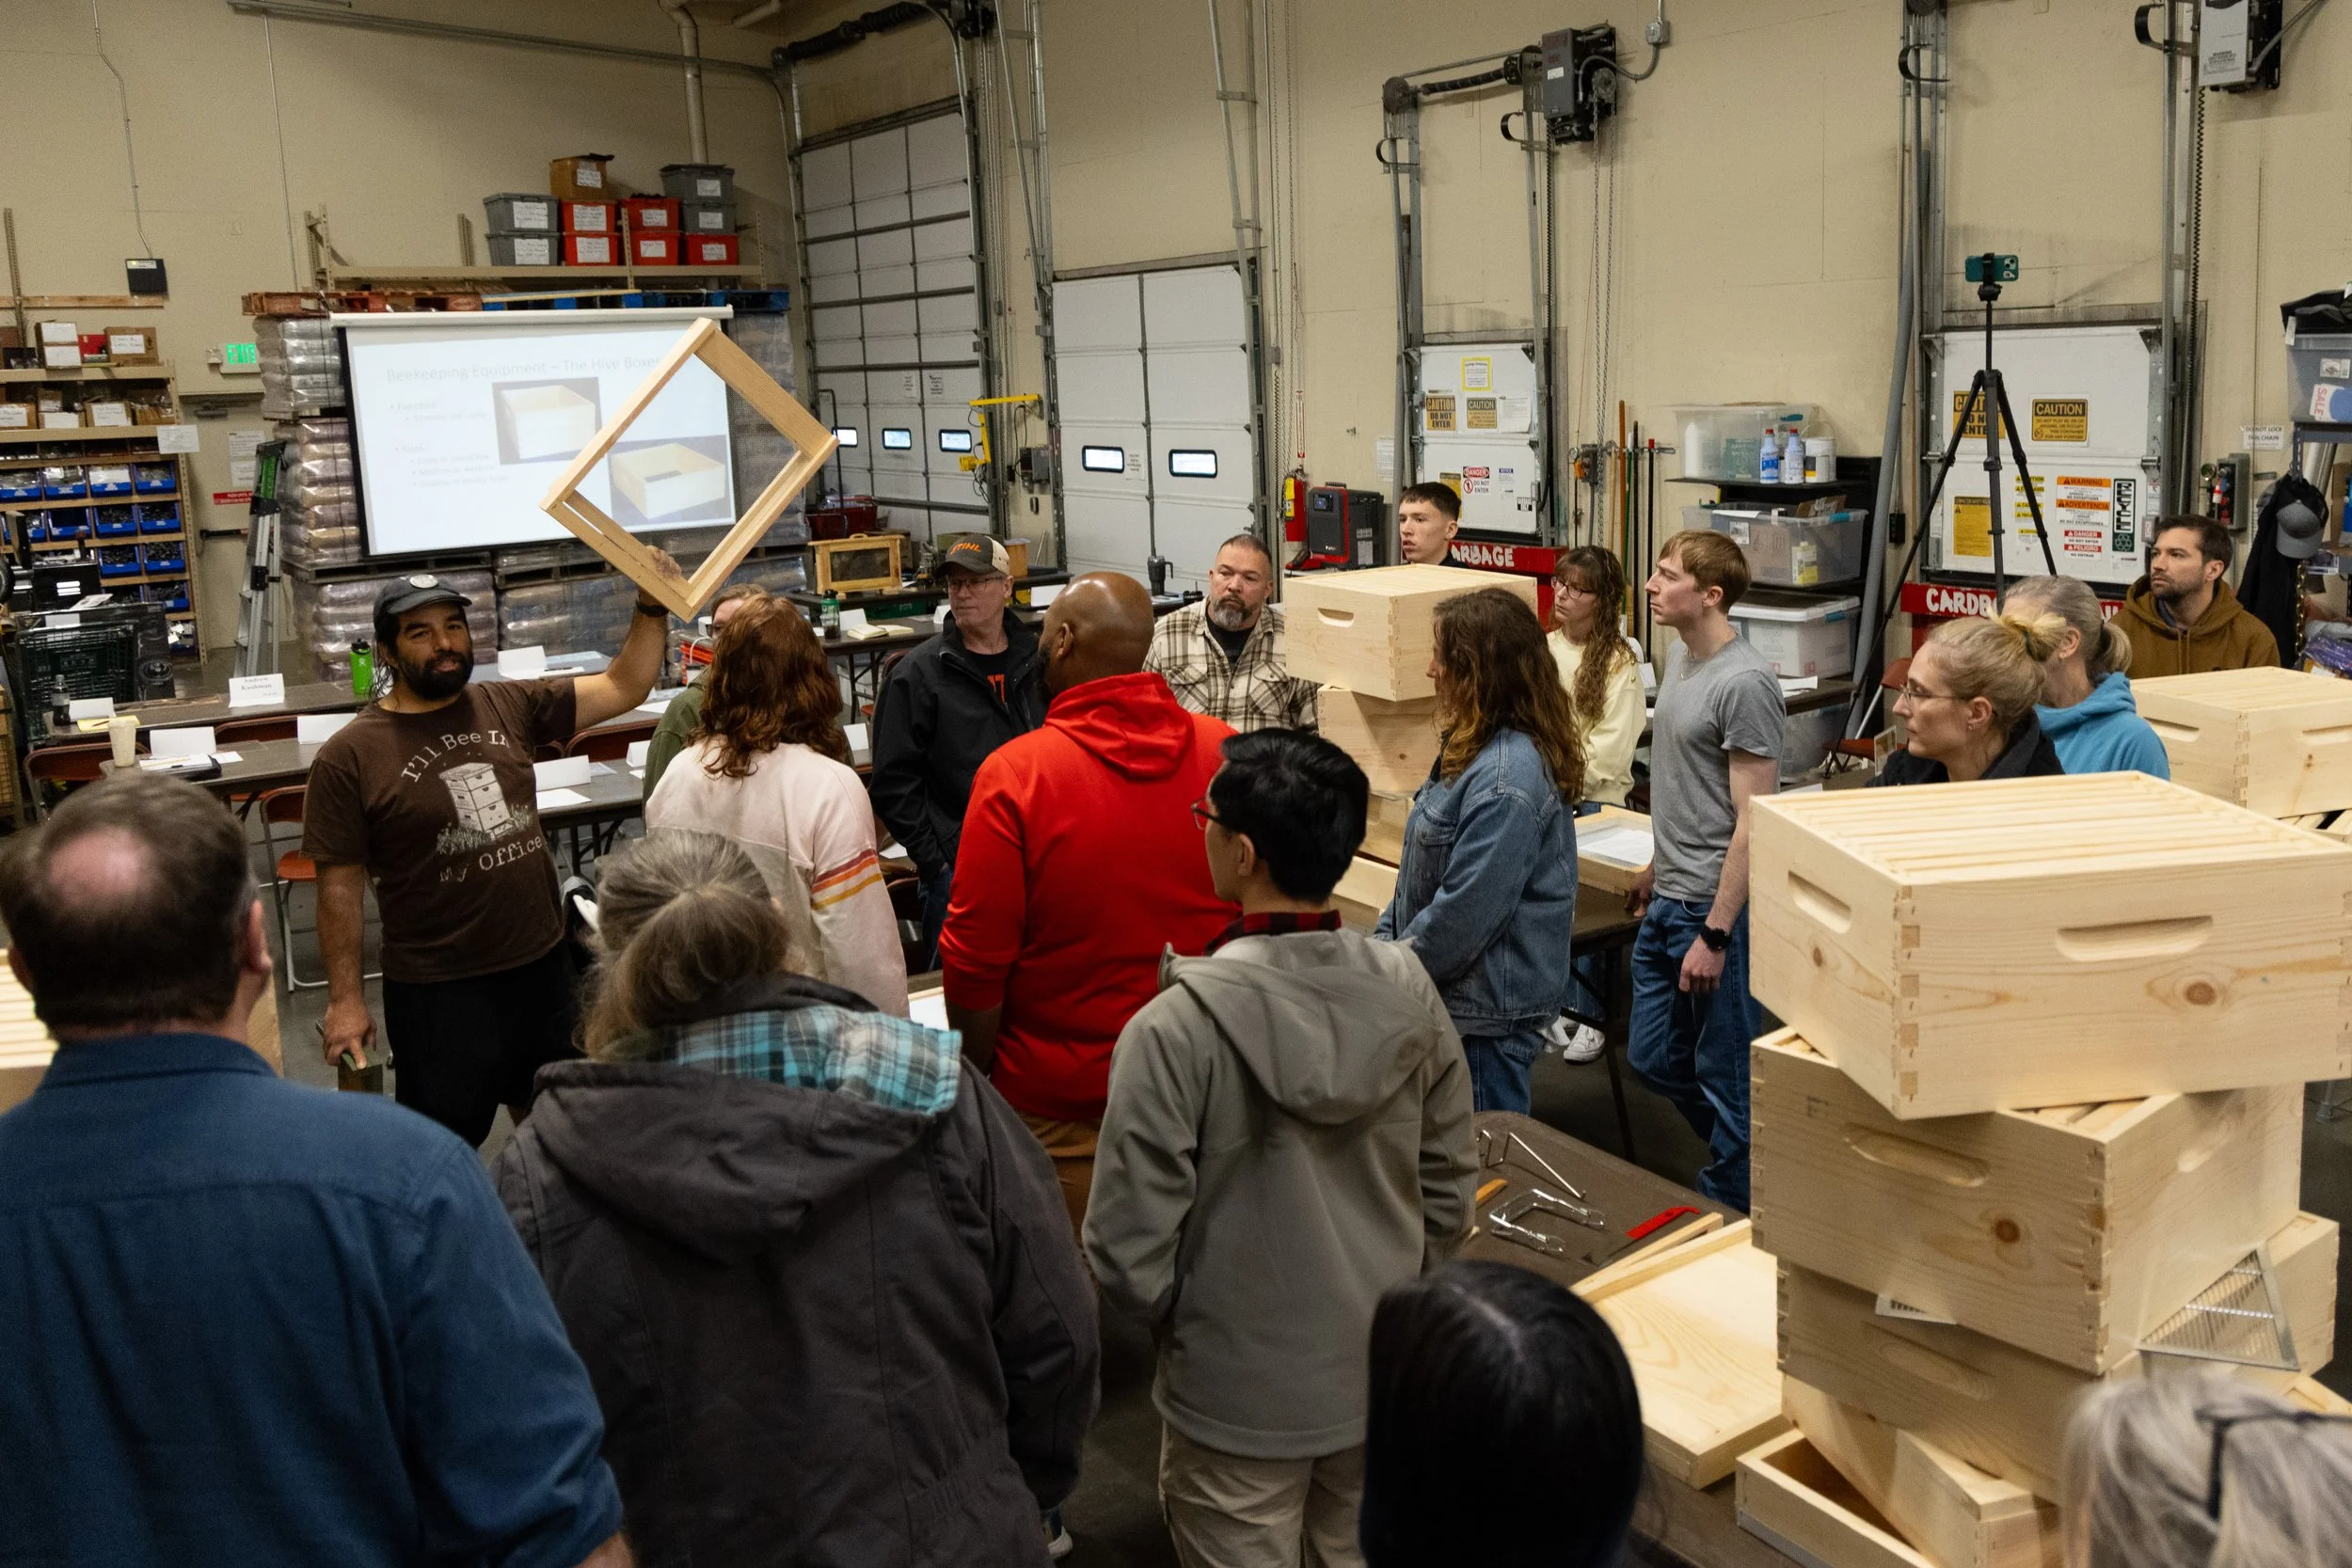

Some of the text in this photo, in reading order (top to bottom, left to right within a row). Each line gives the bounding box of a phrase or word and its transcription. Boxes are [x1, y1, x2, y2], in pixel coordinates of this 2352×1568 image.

[227, 343, 256, 365] EXIT
[387, 367, 469, 384] Beekeeping
[472, 362, 547, 378] Equipment
[564, 359, 588, 372] The
[591, 356, 619, 370] Hive
[1427, 398, 1454, 411] CAUTION
[1468, 400, 1494, 409] CAUTION
[2036, 404, 2083, 415] CAUTION
[2071, 478, 2103, 486] WARNING
[2065, 500, 2109, 510] ADVERTENCIA
[2116, 483, 2133, 531] RECYCLE
[949, 543, 982, 556] STIHL
[1450, 544, 1515, 567] ARBAGE
[401, 746, 443, 783] I'll
[442, 729, 482, 751] Bee
[439, 835, 543, 882] My Office
